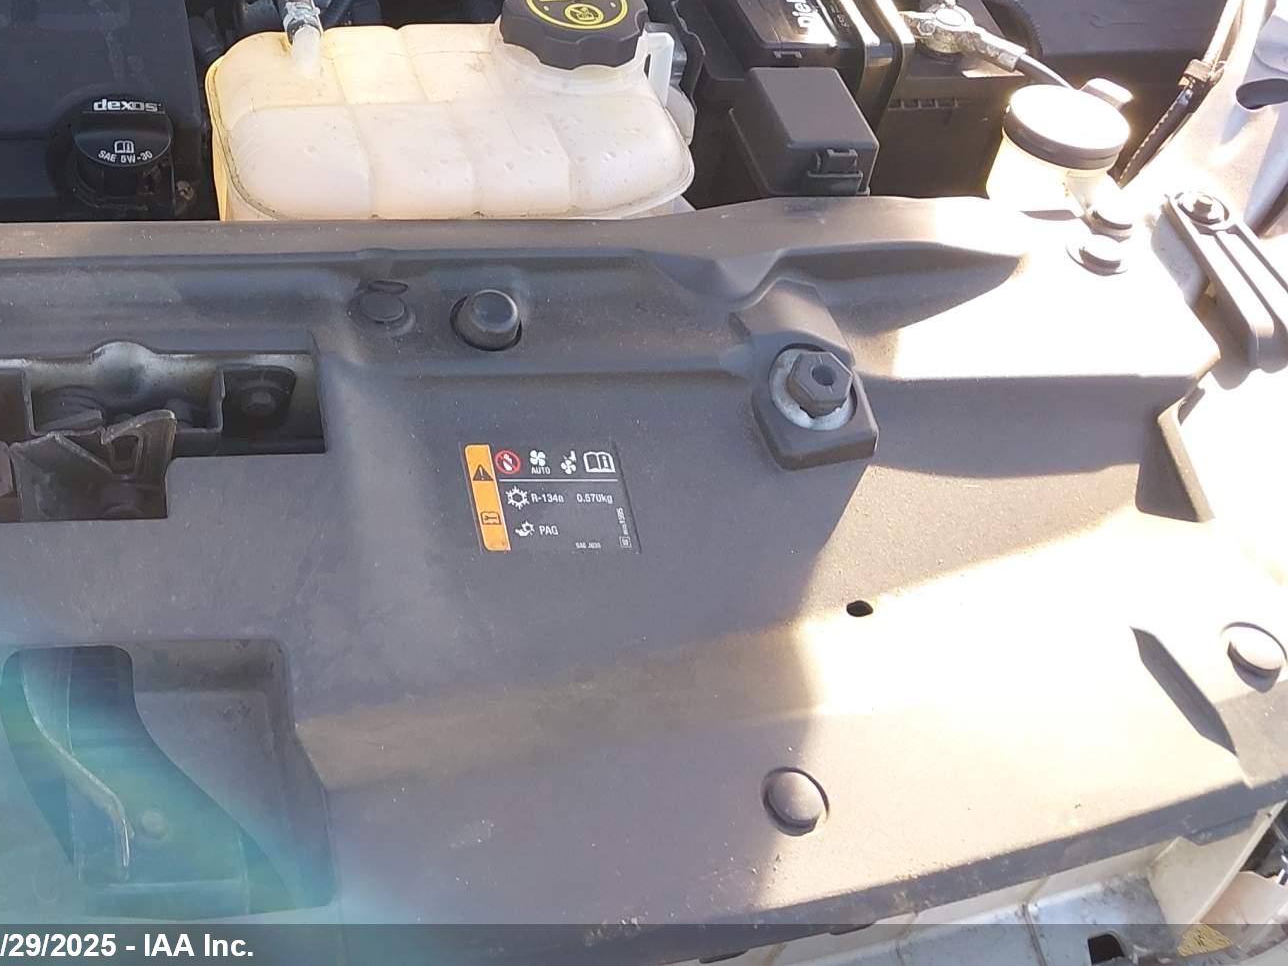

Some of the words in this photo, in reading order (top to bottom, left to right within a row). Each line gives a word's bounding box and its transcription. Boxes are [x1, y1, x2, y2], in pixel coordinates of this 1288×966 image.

[93, 98, 158, 112] dexos
[98, 150, 117, 163] SAE
[120, 150, 153, 164] 5W-30
[531, 467, 551, 475] AUTO
[530, 493, 564, 504] R-134a
[539, 525, 559, 535] PAG
